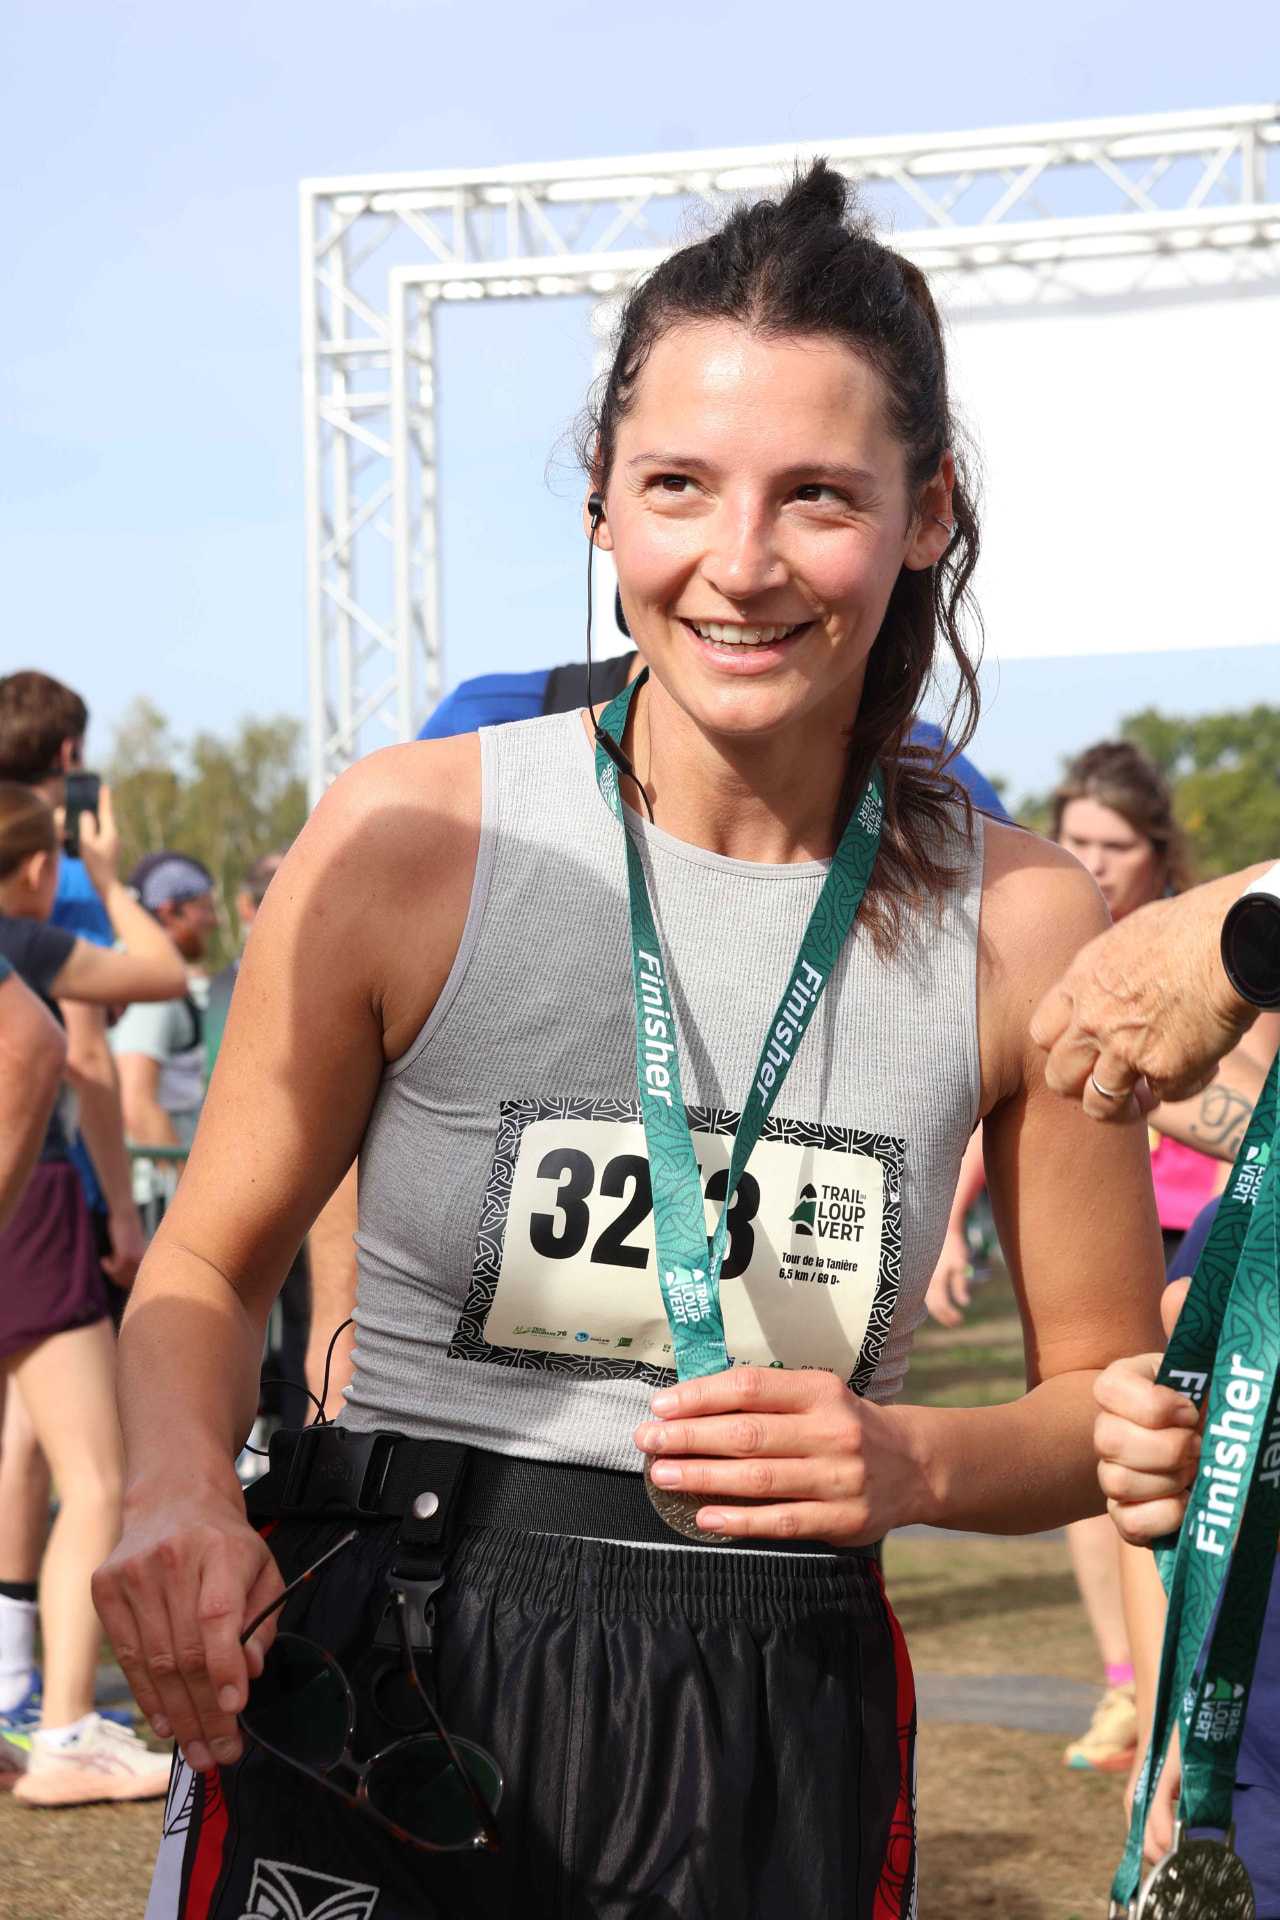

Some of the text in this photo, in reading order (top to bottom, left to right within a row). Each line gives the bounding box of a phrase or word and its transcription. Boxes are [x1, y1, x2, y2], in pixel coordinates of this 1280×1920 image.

[857, 795, 873, 828] VERT
[866, 801, 878, 834] LOUP
[871, 809, 882, 836] TRAIL
[638, 949, 675, 1107] Finisher
[756, 959, 823, 1108] Finisher
[821, 1184, 864, 1205] TRAIL
[1232, 1164, 1258, 1204] VERT
[530, 1147, 761, 1280] 323
[817, 1219, 864, 1242] VERT
[818, 1201, 866, 1223] LOUP
[779, 1267, 840, 1285] 6,5 km / 69 D+
[782, 1252, 858, 1272] Tour de la Tanière
[668, 1286, 688, 1325] VERT
[681, 1283, 700, 1323] LOUP
[695, 1281, 711, 1318] TRAIL
[1195, 1353, 1265, 1556] Finisher
[1194, 1701, 1216, 1741] VERT
[1211, 1701, 1230, 1742] LOUP
